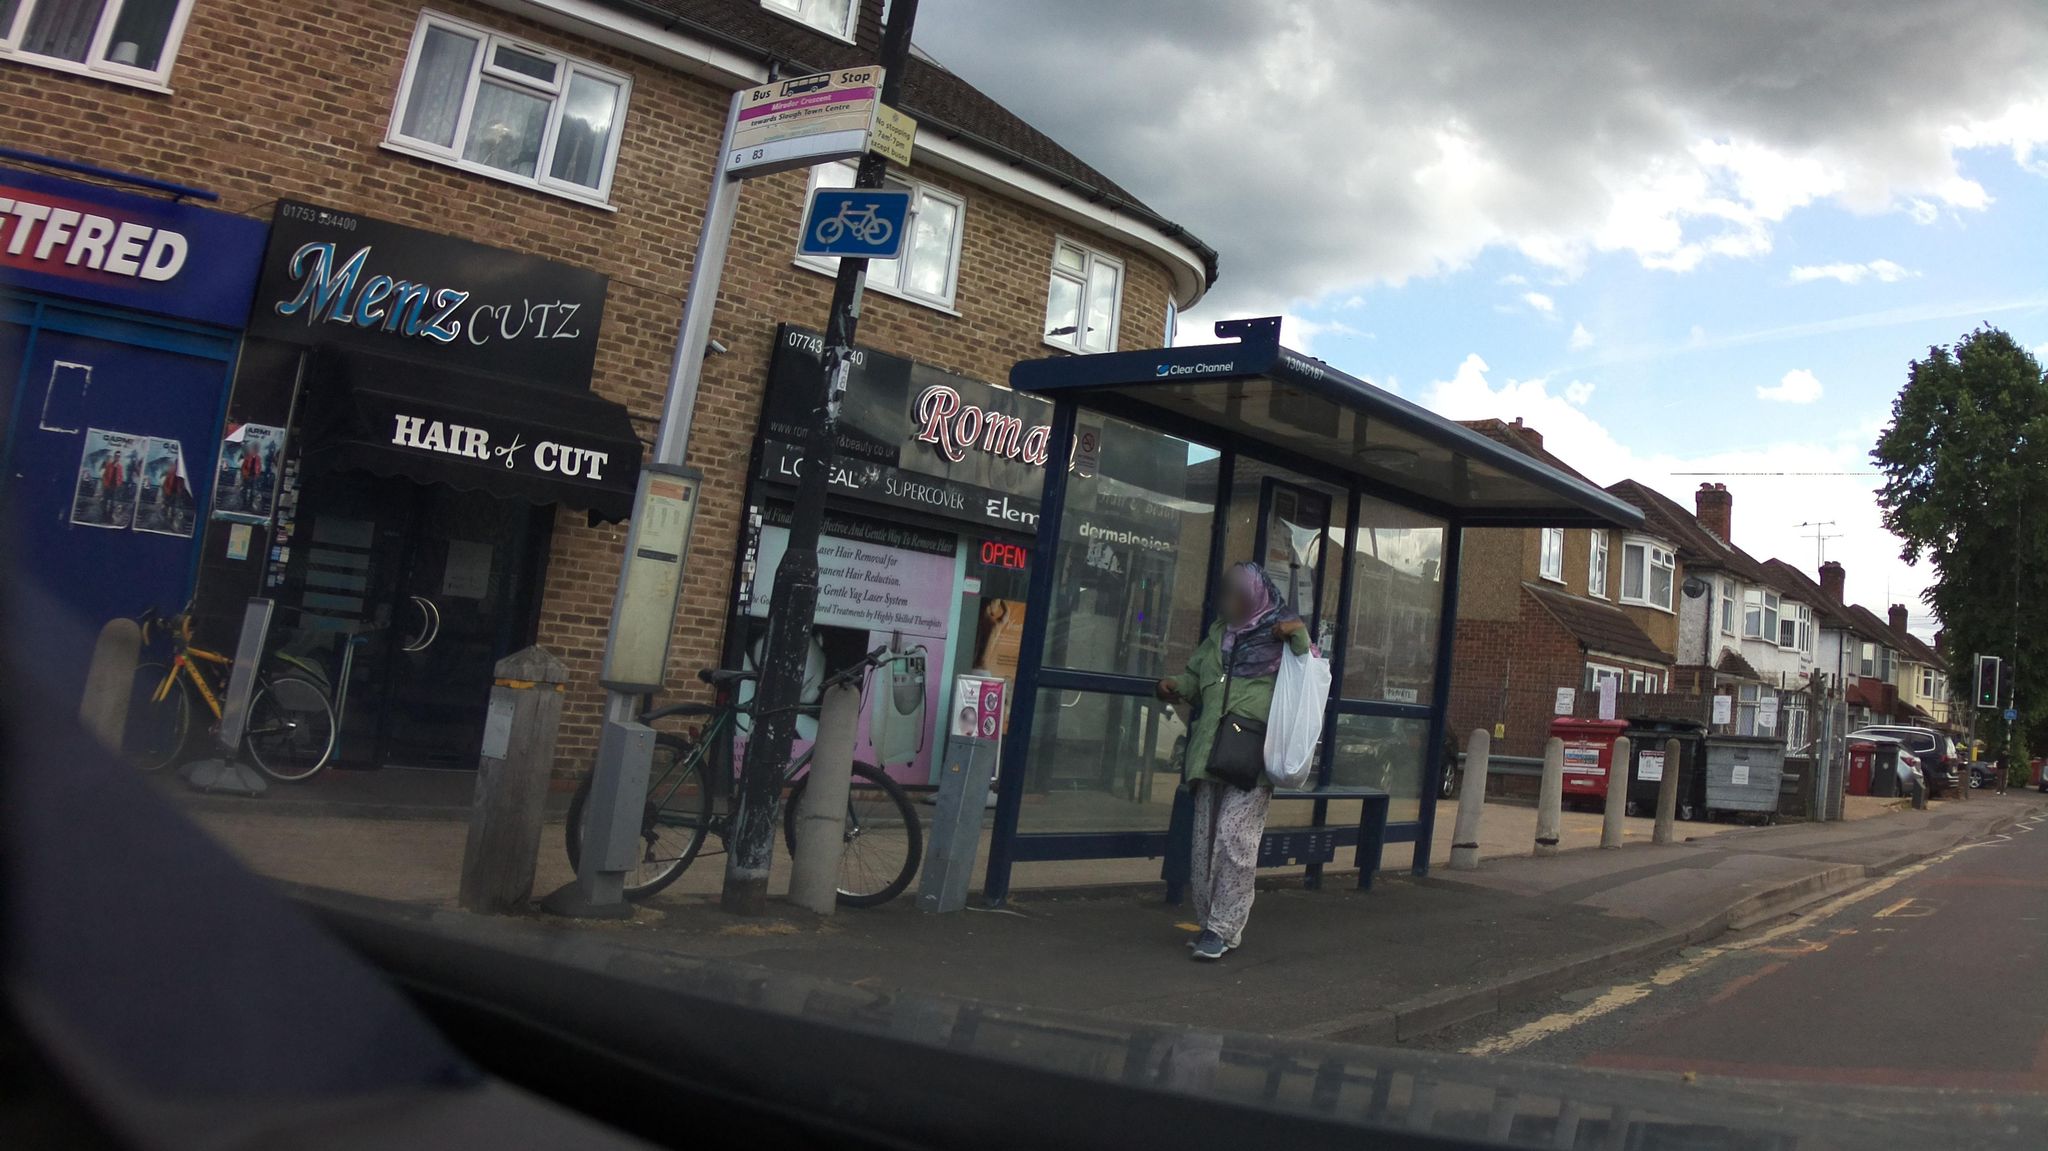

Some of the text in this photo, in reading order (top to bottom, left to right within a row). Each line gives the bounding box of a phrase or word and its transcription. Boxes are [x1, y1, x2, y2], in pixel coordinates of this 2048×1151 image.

[752, 72, 870, 102] Bus Stop
[800, 94, 832, 105] Crescent
[751, 103, 850, 127] towards Slough Town Centre
[876, 116, 910, 141] No stopping
[735, 149, 763, 163] 6 83
[891, 148, 908, 161] buses
[282, 204, 316, 222] 01753
[274, 241, 581, 346] Menz CUTZ
[789, 332, 864, 365] 07743 40
[1170, 361, 1234, 375] Clear Channel
[392, 414, 609, 481] HAIR CUT
[885, 477, 965, 510] SUPERCOVER
[835, 545, 853, 559] Hair
[855, 549, 886, 565] Removal
[885, 555, 898, 569] for
[982, 541, 1026, 569] OPEN
[845, 566, 864, 580] Hair
[864, 570, 901, 586] Reduction.
[824, 584, 848, 598] Gentle
[849, 587, 862, 604] Yag
[863, 590, 883, 601] Laser
[884, 593, 908, 607] System
[832, 604, 865, 617] Treatments
[866, 609, 873, 621] by
[873, 611, 894, 624] Highly
[895, 613, 914, 624] Skilled
[914, 616, 943, 630] Therapists
